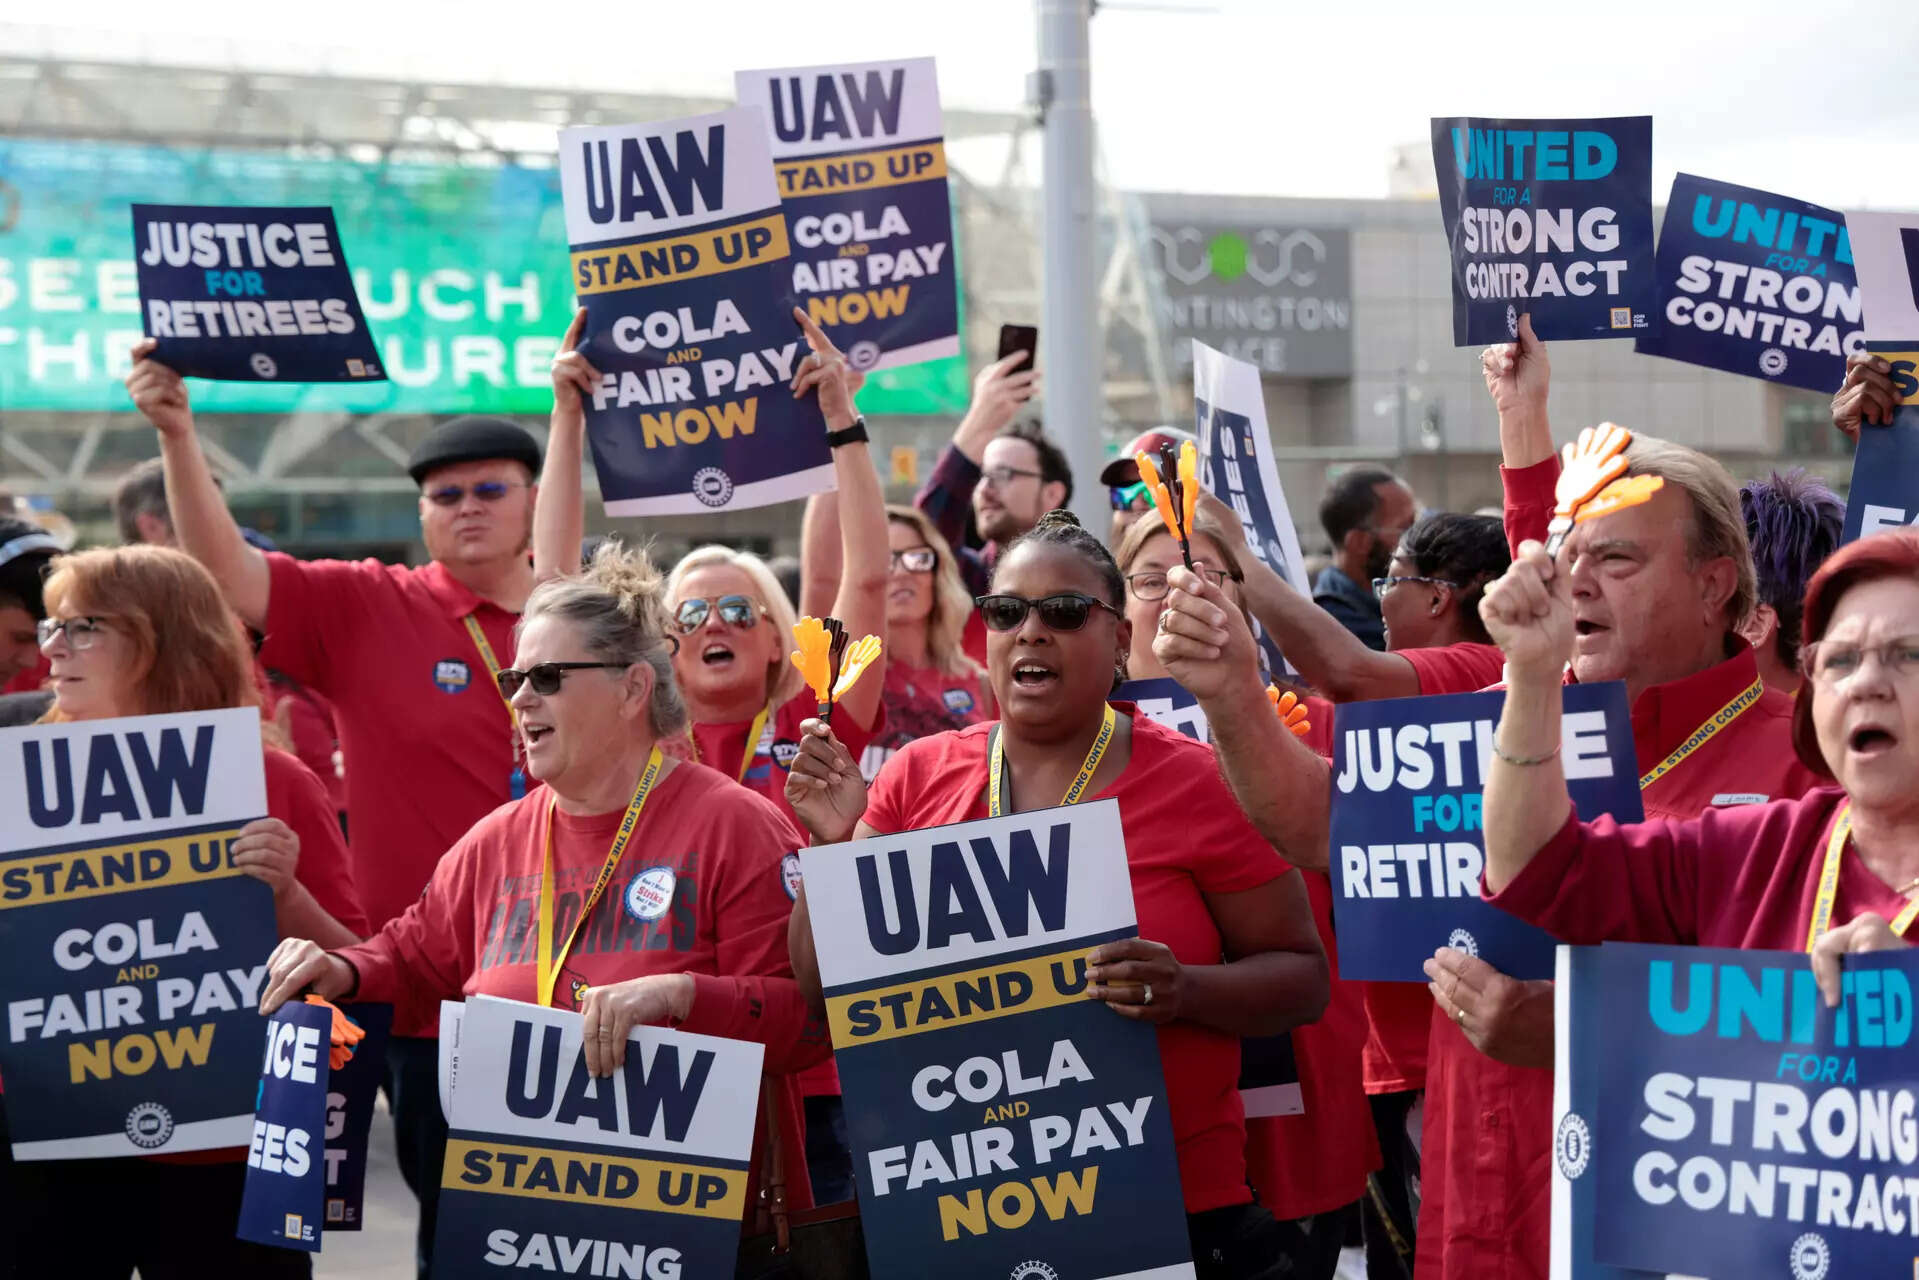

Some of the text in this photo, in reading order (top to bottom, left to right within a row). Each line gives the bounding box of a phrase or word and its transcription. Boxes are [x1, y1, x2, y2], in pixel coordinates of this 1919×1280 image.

[770, 68, 905, 142] UAW
[582, 124, 725, 225] UAW
[780, 152, 933, 192] TAND UP
[1451, 127, 1618, 181] UNITED
[1493, 187, 1532, 205] FOR A
[142, 221, 336, 268] JUSTICE
[793, 205, 911, 248] COLA
[838, 243, 870, 258] AND
[1463, 206, 1620, 254] STRONG
[205, 269, 267, 296] FOR
[578, 227, 772, 288] STAND UP
[792, 242, 946, 294] AIR PAY
[1465, 260, 1628, 299] CONTRACT
[1765, 253, 1828, 278] FOR A
[354, 268, 541, 322] UCH
[807, 284, 910, 328] NOW
[1162, 296, 1349, 331] NTINGTON
[1675, 255, 1862, 323] STRON
[148, 298, 355, 338] RETIREES
[612, 299, 751, 353] COLA
[1666, 296, 1866, 359] CONTRAC
[385, 334, 563, 388] URE
[591, 343, 797, 411] FAIR PAY
[666, 347, 702, 365] AND
[640, 397, 758, 449] NOW
[1063, 721, 1113, 805] TRONG CONTRACT
[1337, 710, 1614, 793] JUSTIE
[1656, 766, 1666, 774] A
[1667, 723, 1716, 766] STRONG
[22, 725, 215, 829] UAW
[632, 764, 657, 809] FIGHTING
[621, 810, 637, 833] FOR
[1412, 794, 1483, 833] FOR
[2, 847, 172, 900] STAND
[611, 835, 627, 859] THE
[1341, 842, 1485, 898] RETIR
[637, 886, 664, 905] Strike
[855, 823, 1071, 956] UAW
[53, 911, 219, 972] COLA
[115, 963, 160, 982] AND
[847, 957, 1100, 1036] STAND U
[8, 965, 269, 1043] FAIR PAY
[68, 1023, 216, 1084] NOW
[911, 1039, 1095, 1112] COLA
[1776, 1053, 1857, 1083] FOR A
[505, 1020, 717, 1144] UAW
[983, 1100, 1030, 1125] AND
[1640, 1072, 1918, 1165] STRONG
[868, 1096, 1154, 1198] FAIR PAY
[460, 1149, 729, 1210] STAND UP
[937, 1166, 1099, 1241] NOW
[1633, 1150, 1919, 1237] CONTRACT
[483, 1228, 683, 1280] SAVING
